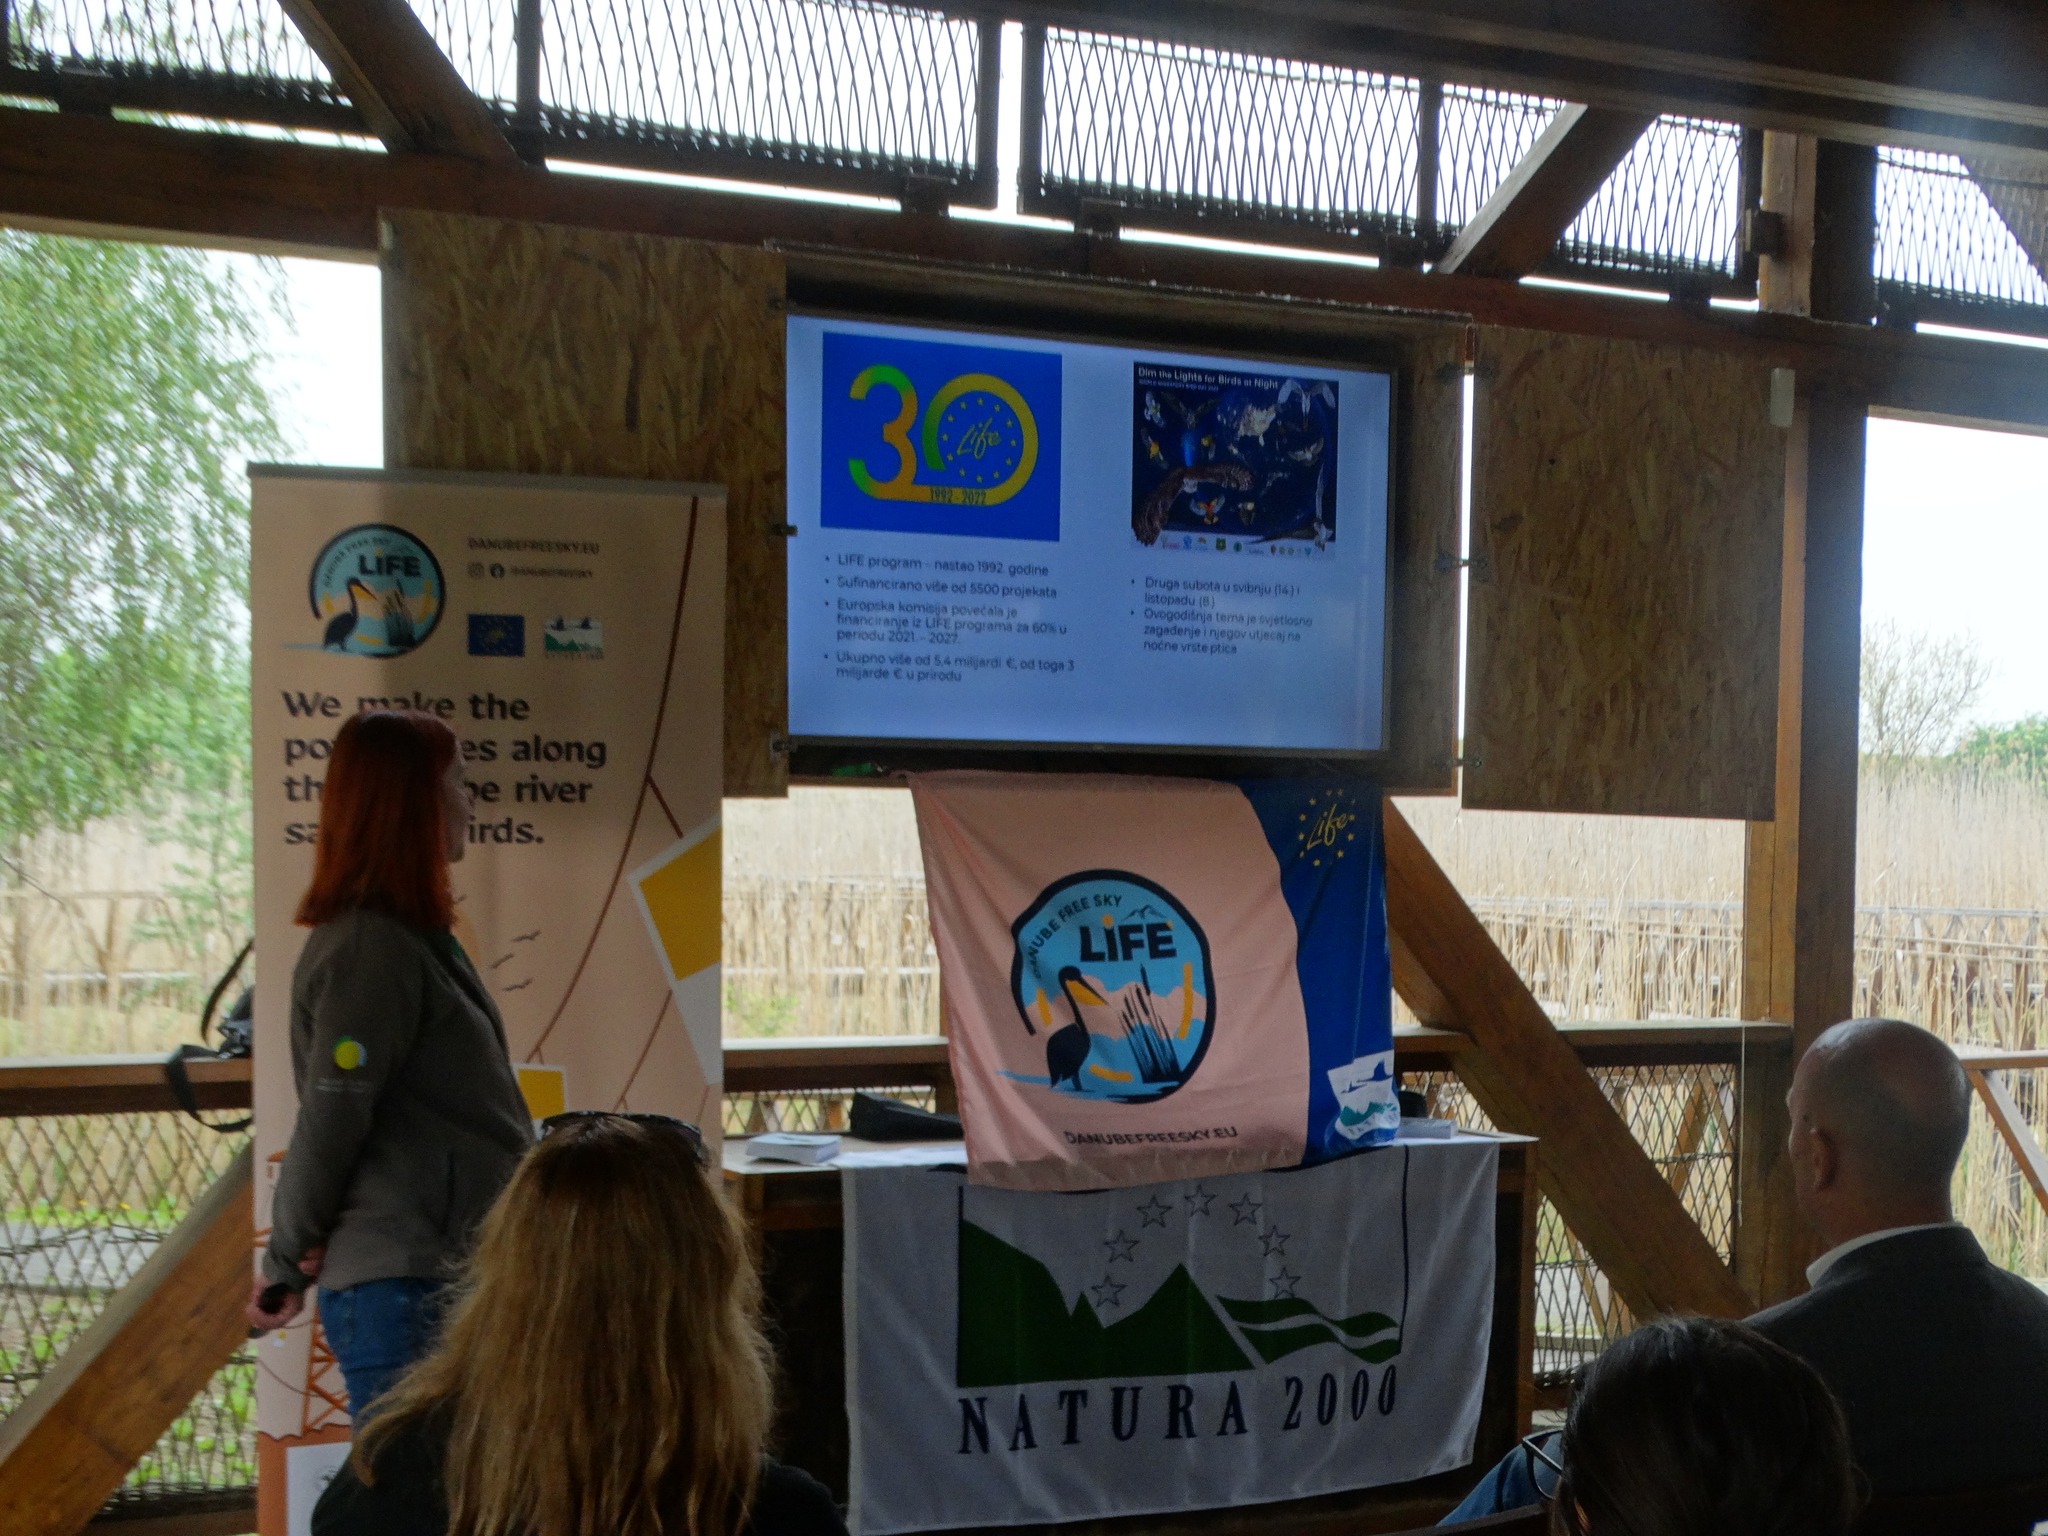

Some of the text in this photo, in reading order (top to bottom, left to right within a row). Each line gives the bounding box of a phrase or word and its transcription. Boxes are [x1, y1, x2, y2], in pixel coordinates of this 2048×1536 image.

[1138, 367, 1157, 377] Dim
[1159, 370, 1172, 379] the
[1174, 370, 1203, 383] Lights
[1204, 374, 1216, 383] for
[1218, 374, 1241, 385] Birds
[1254, 378, 1279, 390] Night
[358, 547, 422, 578] LIFE
[838, 553, 865, 567] LIFE
[868, 556, 922, 570] program
[934, 559, 974, 573] nastao
[1008, 563, 1049, 577] godine
[837, 575, 1057, 599] Sufinancirano više od 5500 projekata
[1145, 576, 1180, 591] Druga
[1183, 580, 1221, 593] subota
[1223, 583, 1231, 593] u
[1233, 583, 1271, 597] svibnju
[837, 597, 895, 613] Europska
[898, 600, 948, 615] komisija
[1006, 607, 1018, 620] je
[1144, 592, 1195, 607] listopadu
[837, 612, 1067, 635] financiranje iz LIFE programa za 60% u
[1144, 606, 1313, 628] Ovogodišnja tema je svjetlosno
[837, 629, 885, 642] periodu
[1210, 627, 1246, 642] njegov
[1249, 629, 1286, 643] utjecaj
[1288, 631, 1301, 642] na
[1181, 642, 1209, 654] vrste
[1210, 642, 1237, 657] ptica
[836, 650, 886, 666] Ukupno
[888, 653, 912, 666] više
[915, 654, 931, 666] od
[954, 655, 1002, 670] milijardi
[1020, 658, 1035, 670] od
[1038, 659, 1065, 674] toga
[1068, 658, 1075, 671] 3
[836, 667, 962, 682] milijarde € u prirodu
[283, 691, 342, 718] We
[469, 692, 530, 720] the
[510, 734, 607, 768] along
[283, 774, 323, 802] th
[515, 774, 593, 803] river
[467, 817, 545, 846] irds.
[1306, 804, 1348, 850] Life
[1057, 897, 1090, 923] FREE
[1093, 894, 1122, 908] SKY
[1080, 914, 1177, 963] LIFE
[958, 1363, 1397, 1454] NATURA 2000
